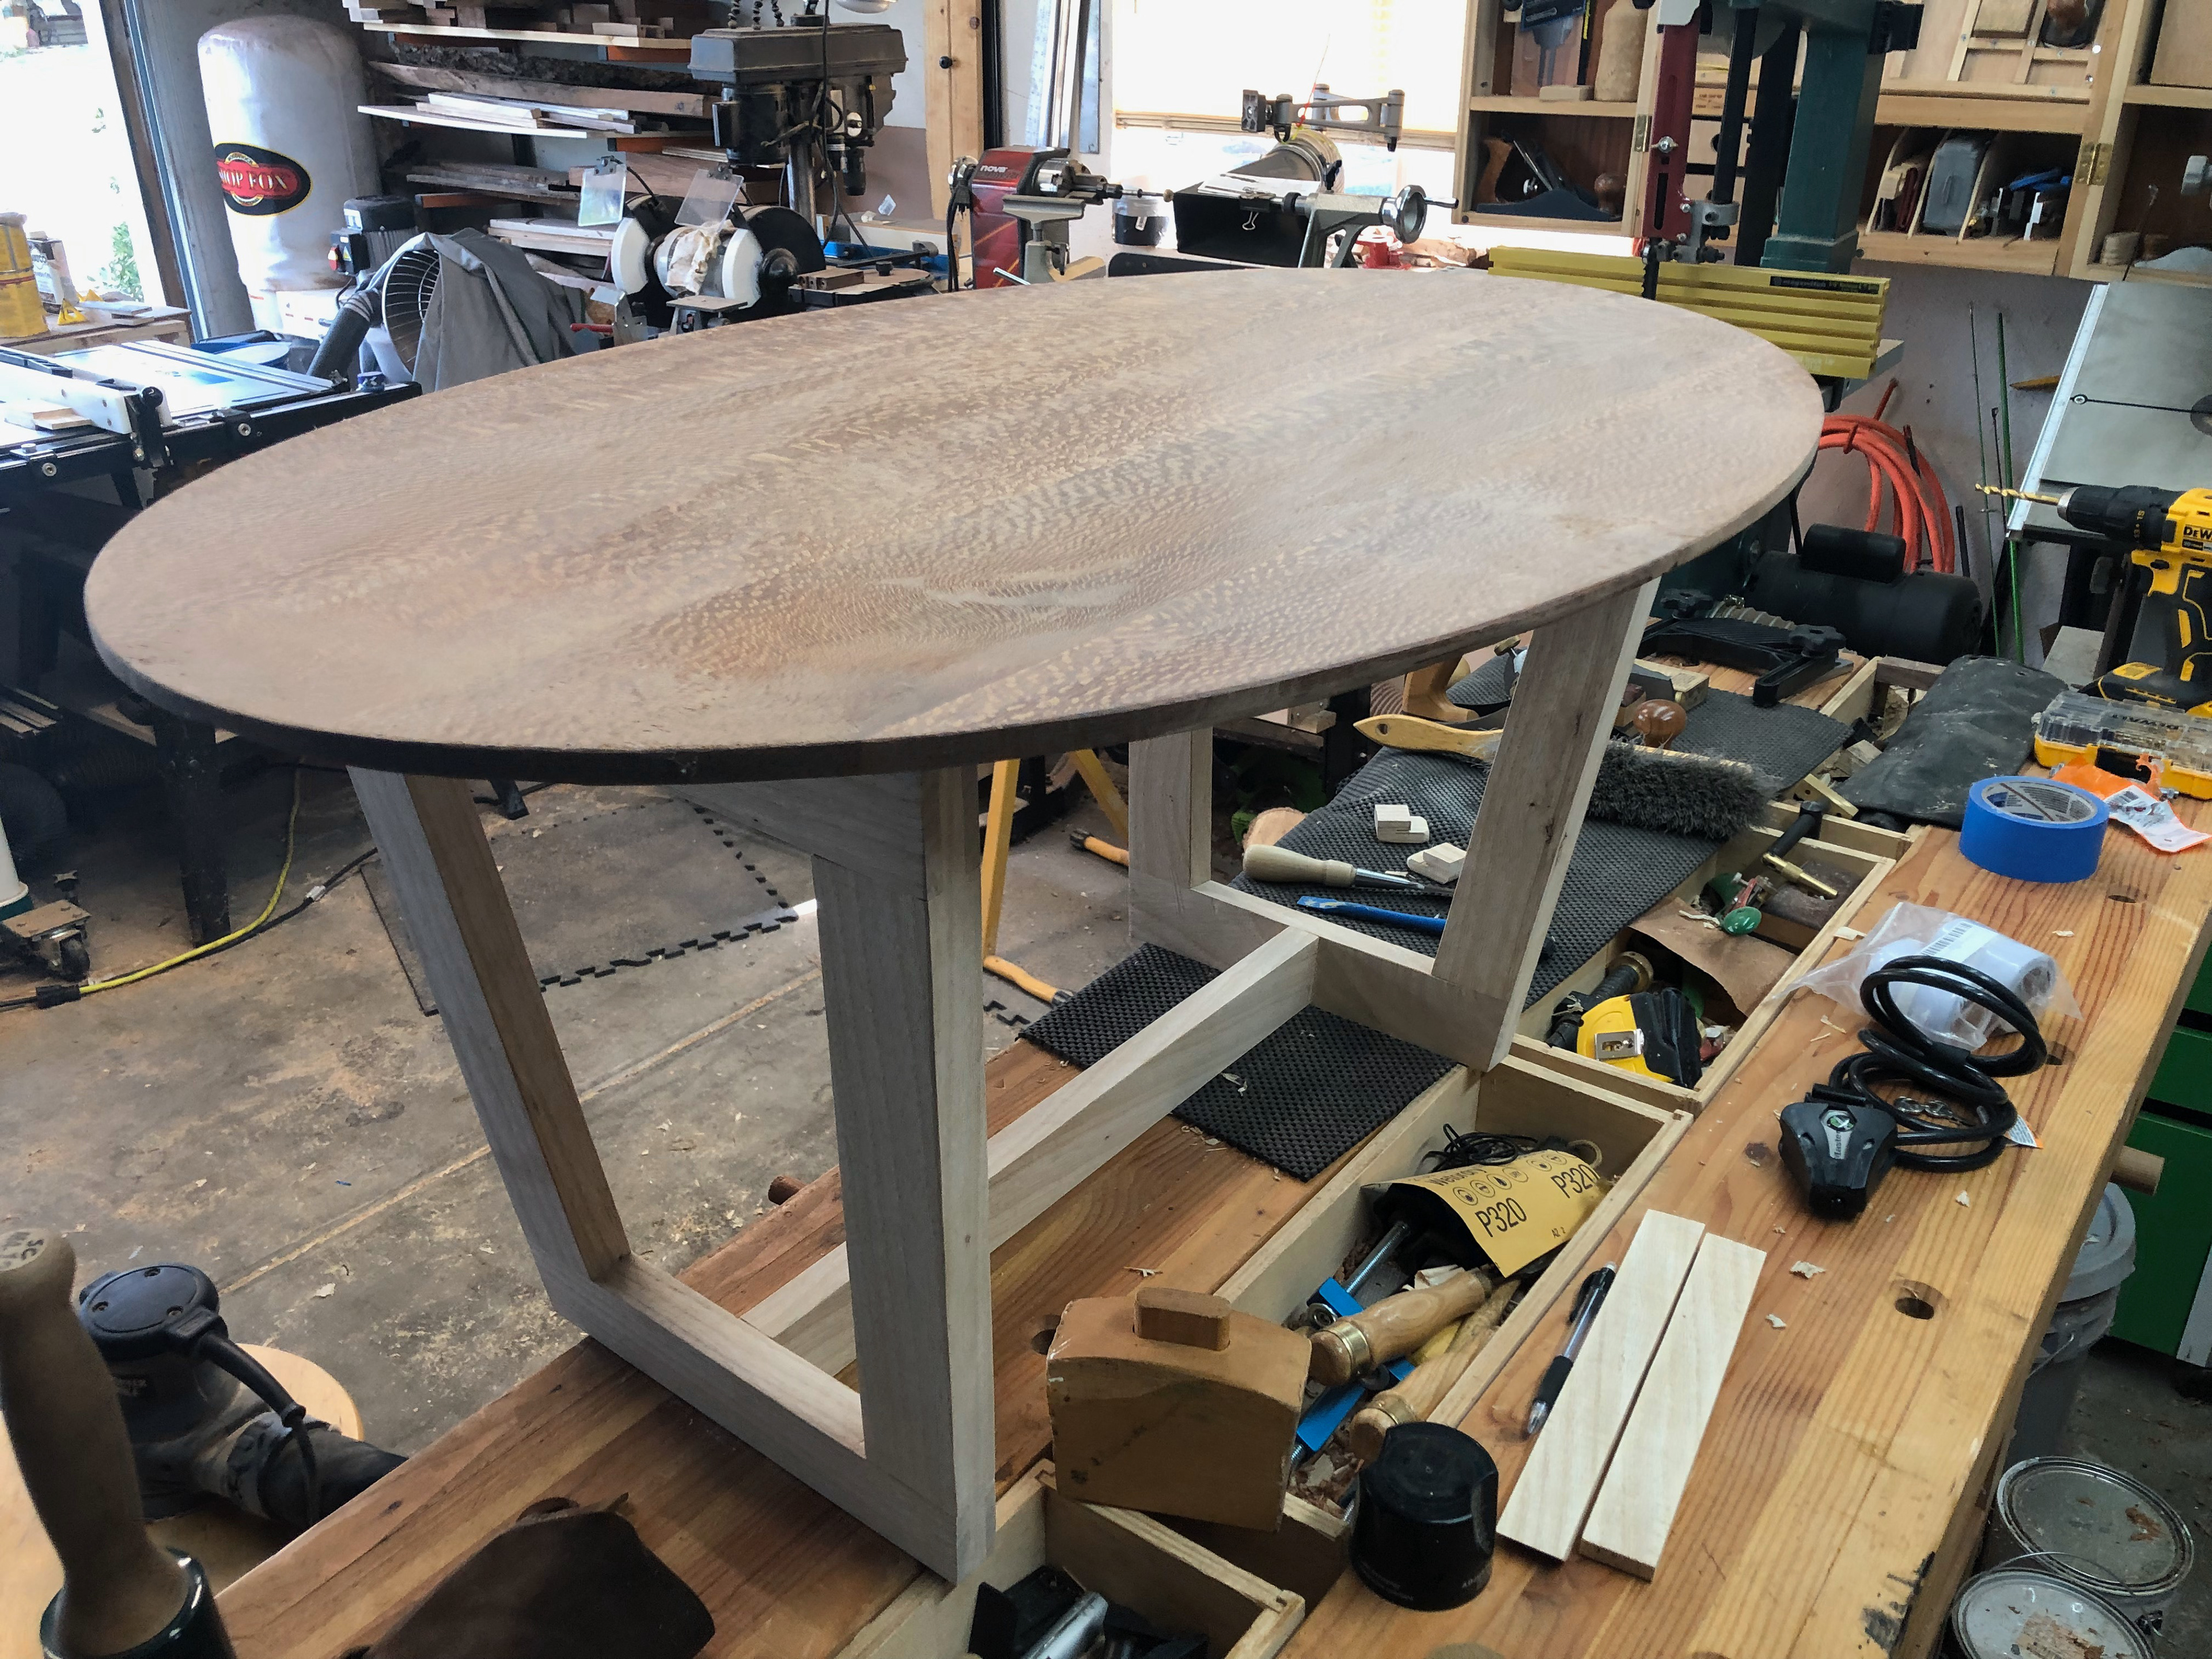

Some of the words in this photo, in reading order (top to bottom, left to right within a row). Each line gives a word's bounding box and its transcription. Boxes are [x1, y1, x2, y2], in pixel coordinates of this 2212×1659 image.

[247, 171, 287, 190] FOX
[980, 165, 1006, 173] nova
[1550, 1164, 1599, 1199] P320
[1474, 1197, 1527, 1238] P320
